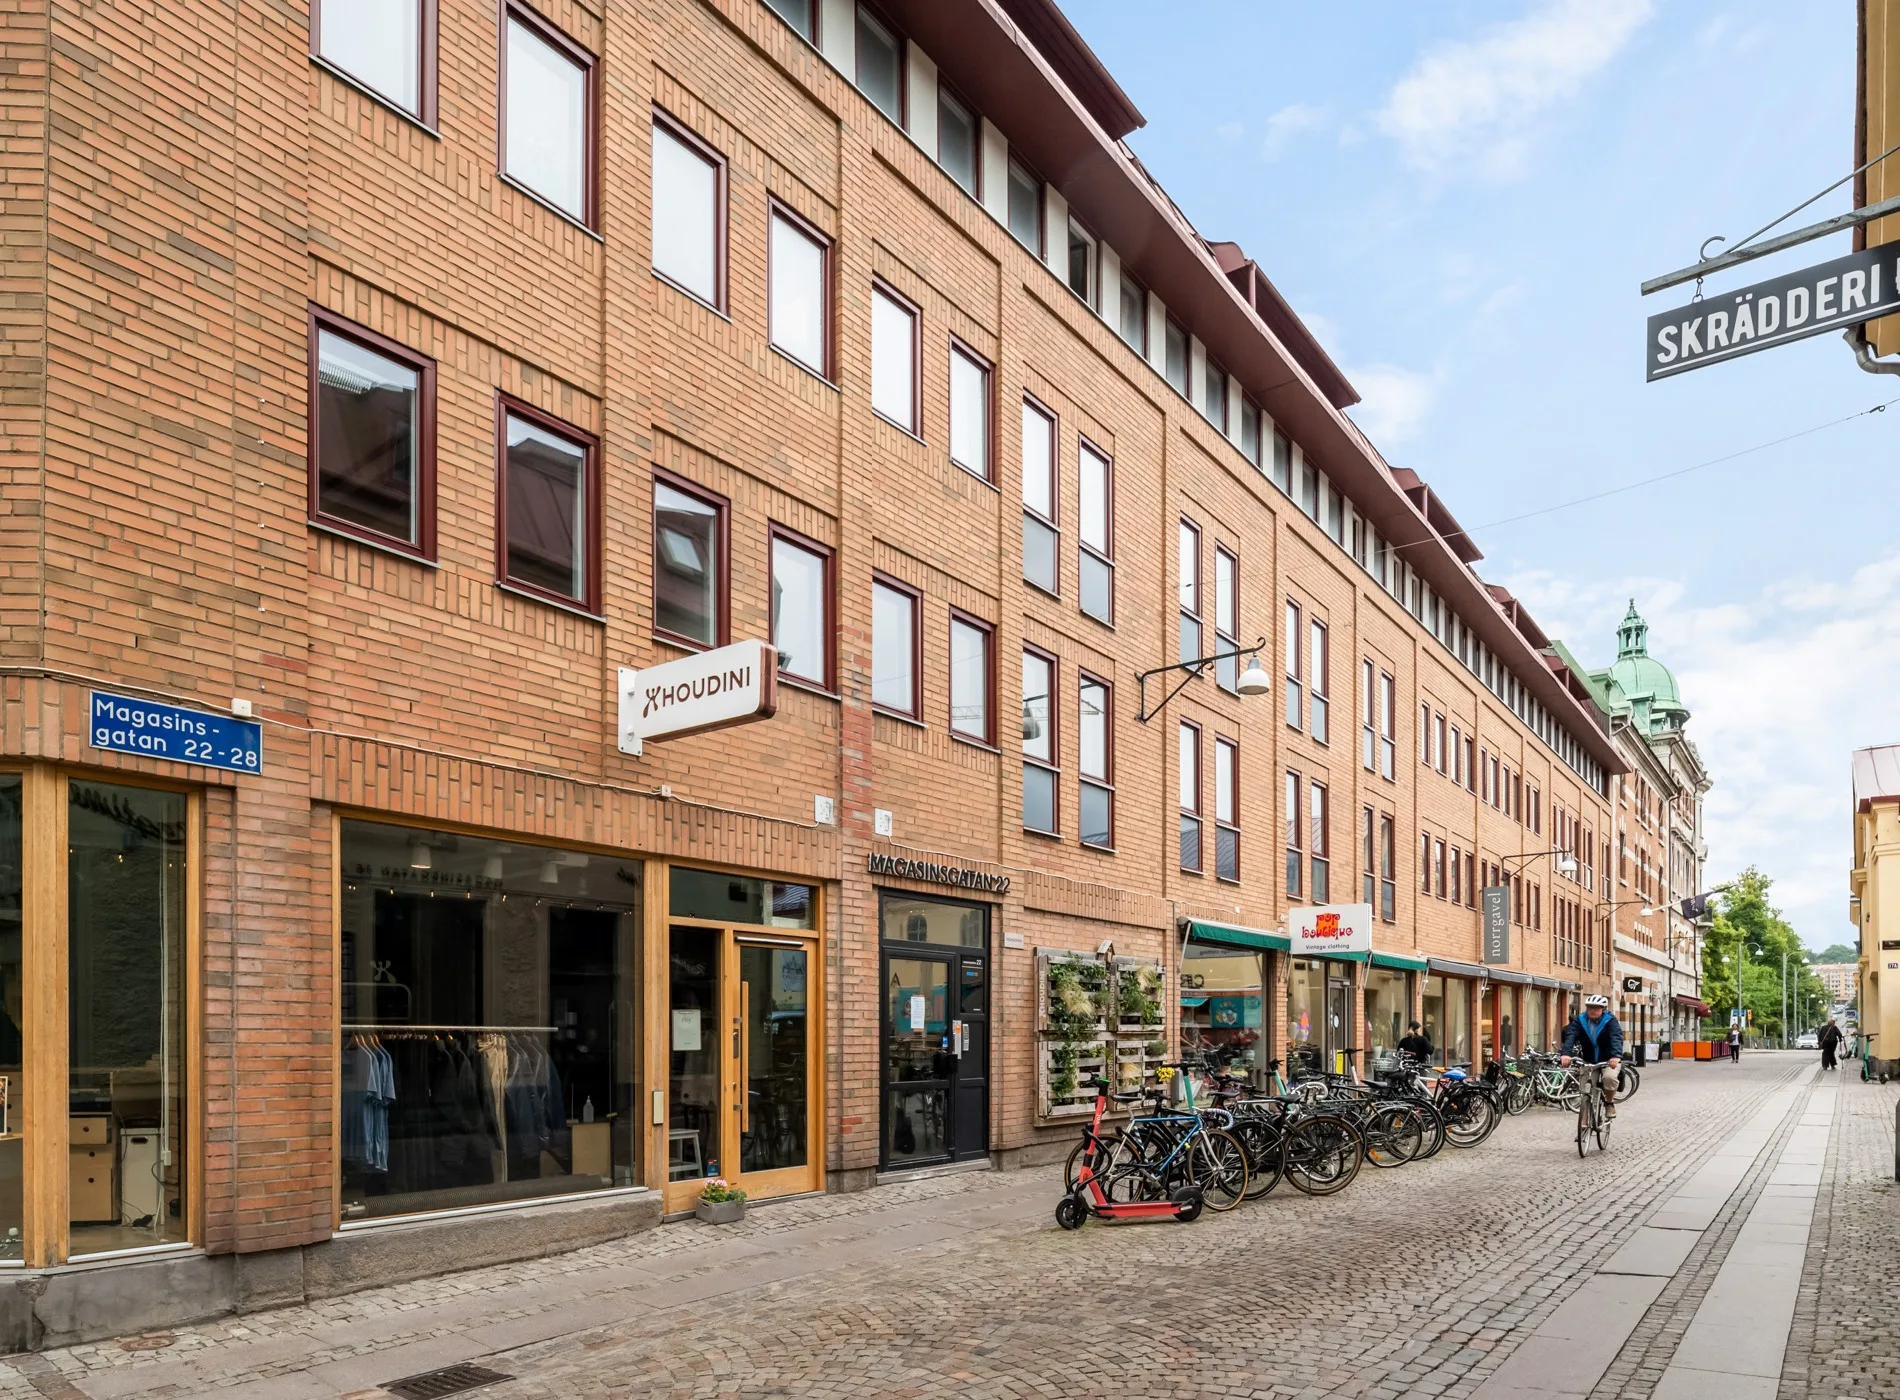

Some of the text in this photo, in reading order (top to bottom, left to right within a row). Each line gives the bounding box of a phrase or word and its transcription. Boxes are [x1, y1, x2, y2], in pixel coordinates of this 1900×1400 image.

[1656, 262, 1881, 364] SKRÄDDERI
[662, 666, 751, 708] HOUDINI
[95, 726, 168, 752] gatan
[868, 852, 1011, 894] MAGASINSGATAN 22
[1301, 926, 1354, 940] boutique
[1316, 913, 1341, 927] pop
[1488, 891, 1505, 958] norrgavel
